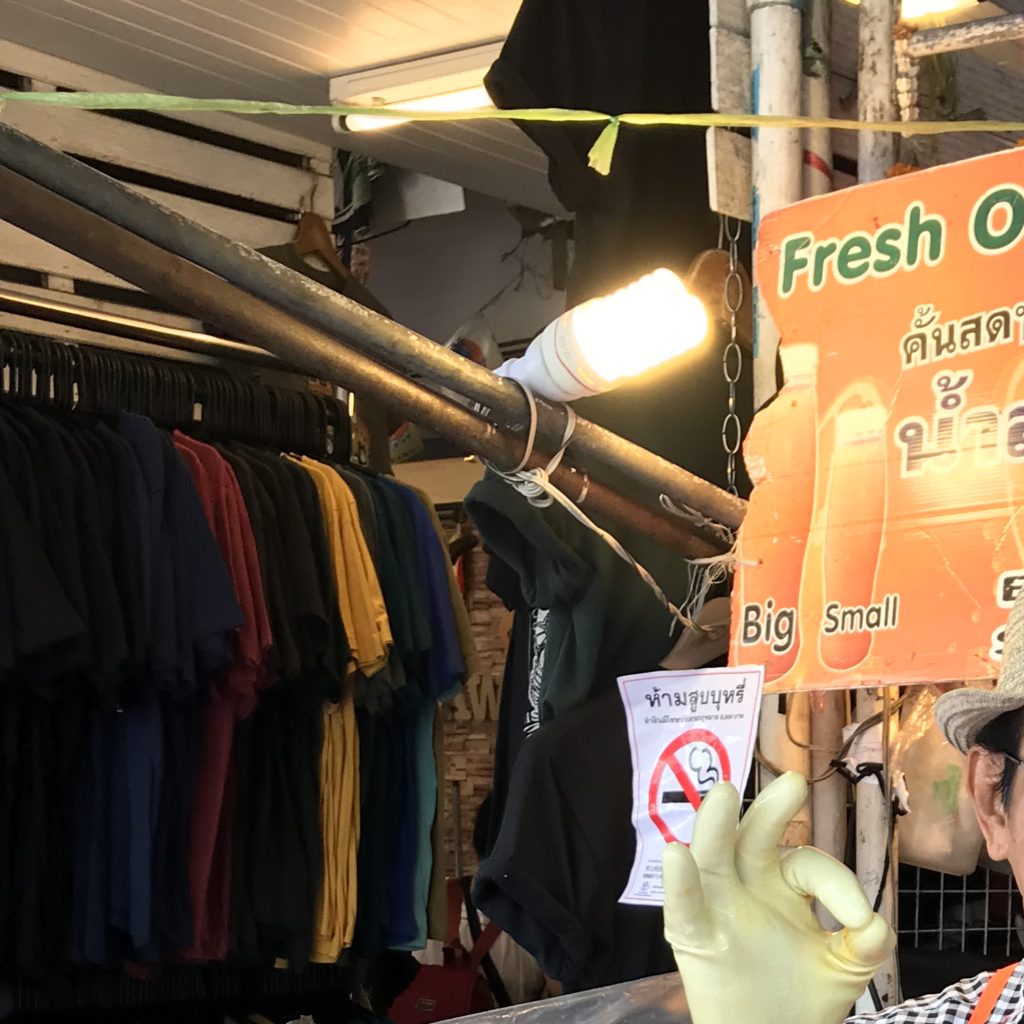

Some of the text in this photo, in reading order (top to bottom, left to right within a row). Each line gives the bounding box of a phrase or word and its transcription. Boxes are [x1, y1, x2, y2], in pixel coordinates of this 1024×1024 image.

[780, 204, 945, 295] Fresh
[741, 593, 899, 653] Big Small
[644, 677, 748, 714] ห้ามสูบบุหรี่
